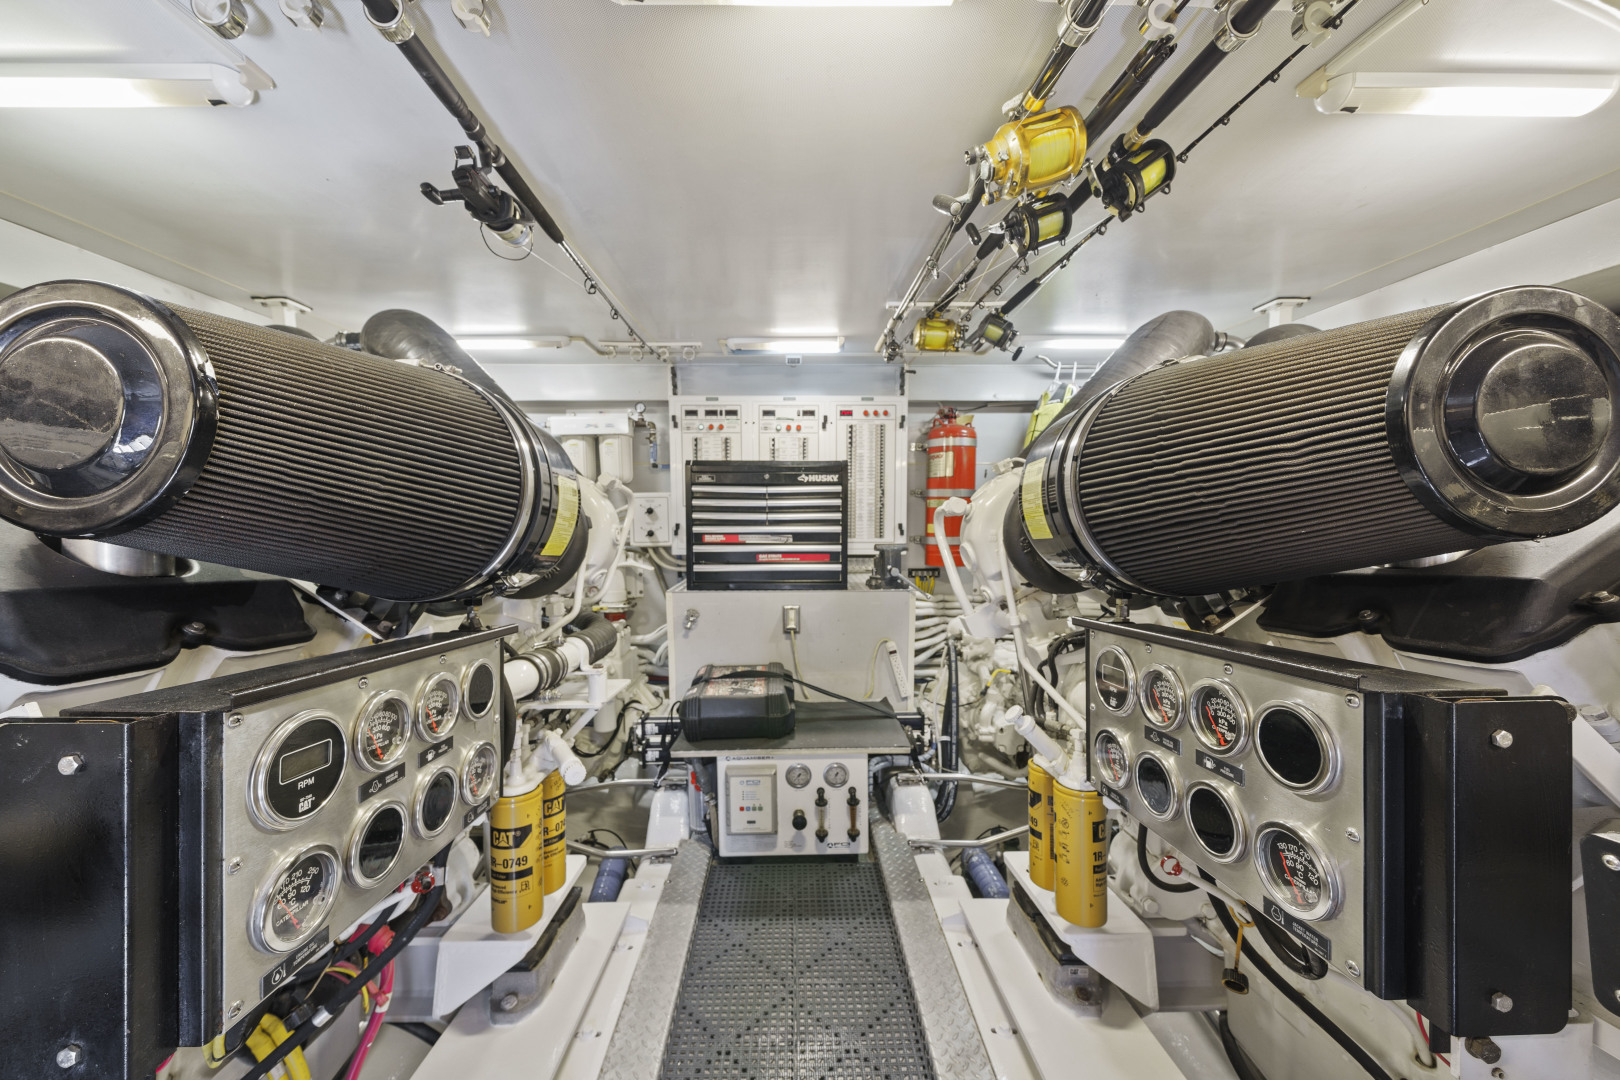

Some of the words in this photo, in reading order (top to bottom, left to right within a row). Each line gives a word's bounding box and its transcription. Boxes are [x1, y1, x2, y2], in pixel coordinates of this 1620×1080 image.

[808, 474, 839, 482] HUSKY
[297, 776, 315, 790] RPM
[298, 798, 312, 813] CAT
[544, 795, 563, 816] CAT
[492, 830, 514, 847] CAT
[1287, 843, 1298, 852] 170
[491, 855, 528, 869] R-0749
[291, 869, 303, 880] 210
[1308, 872, 1319, 886] 120
[287, 889, 297, 900] 90
[300, 885, 310, 893] 120
